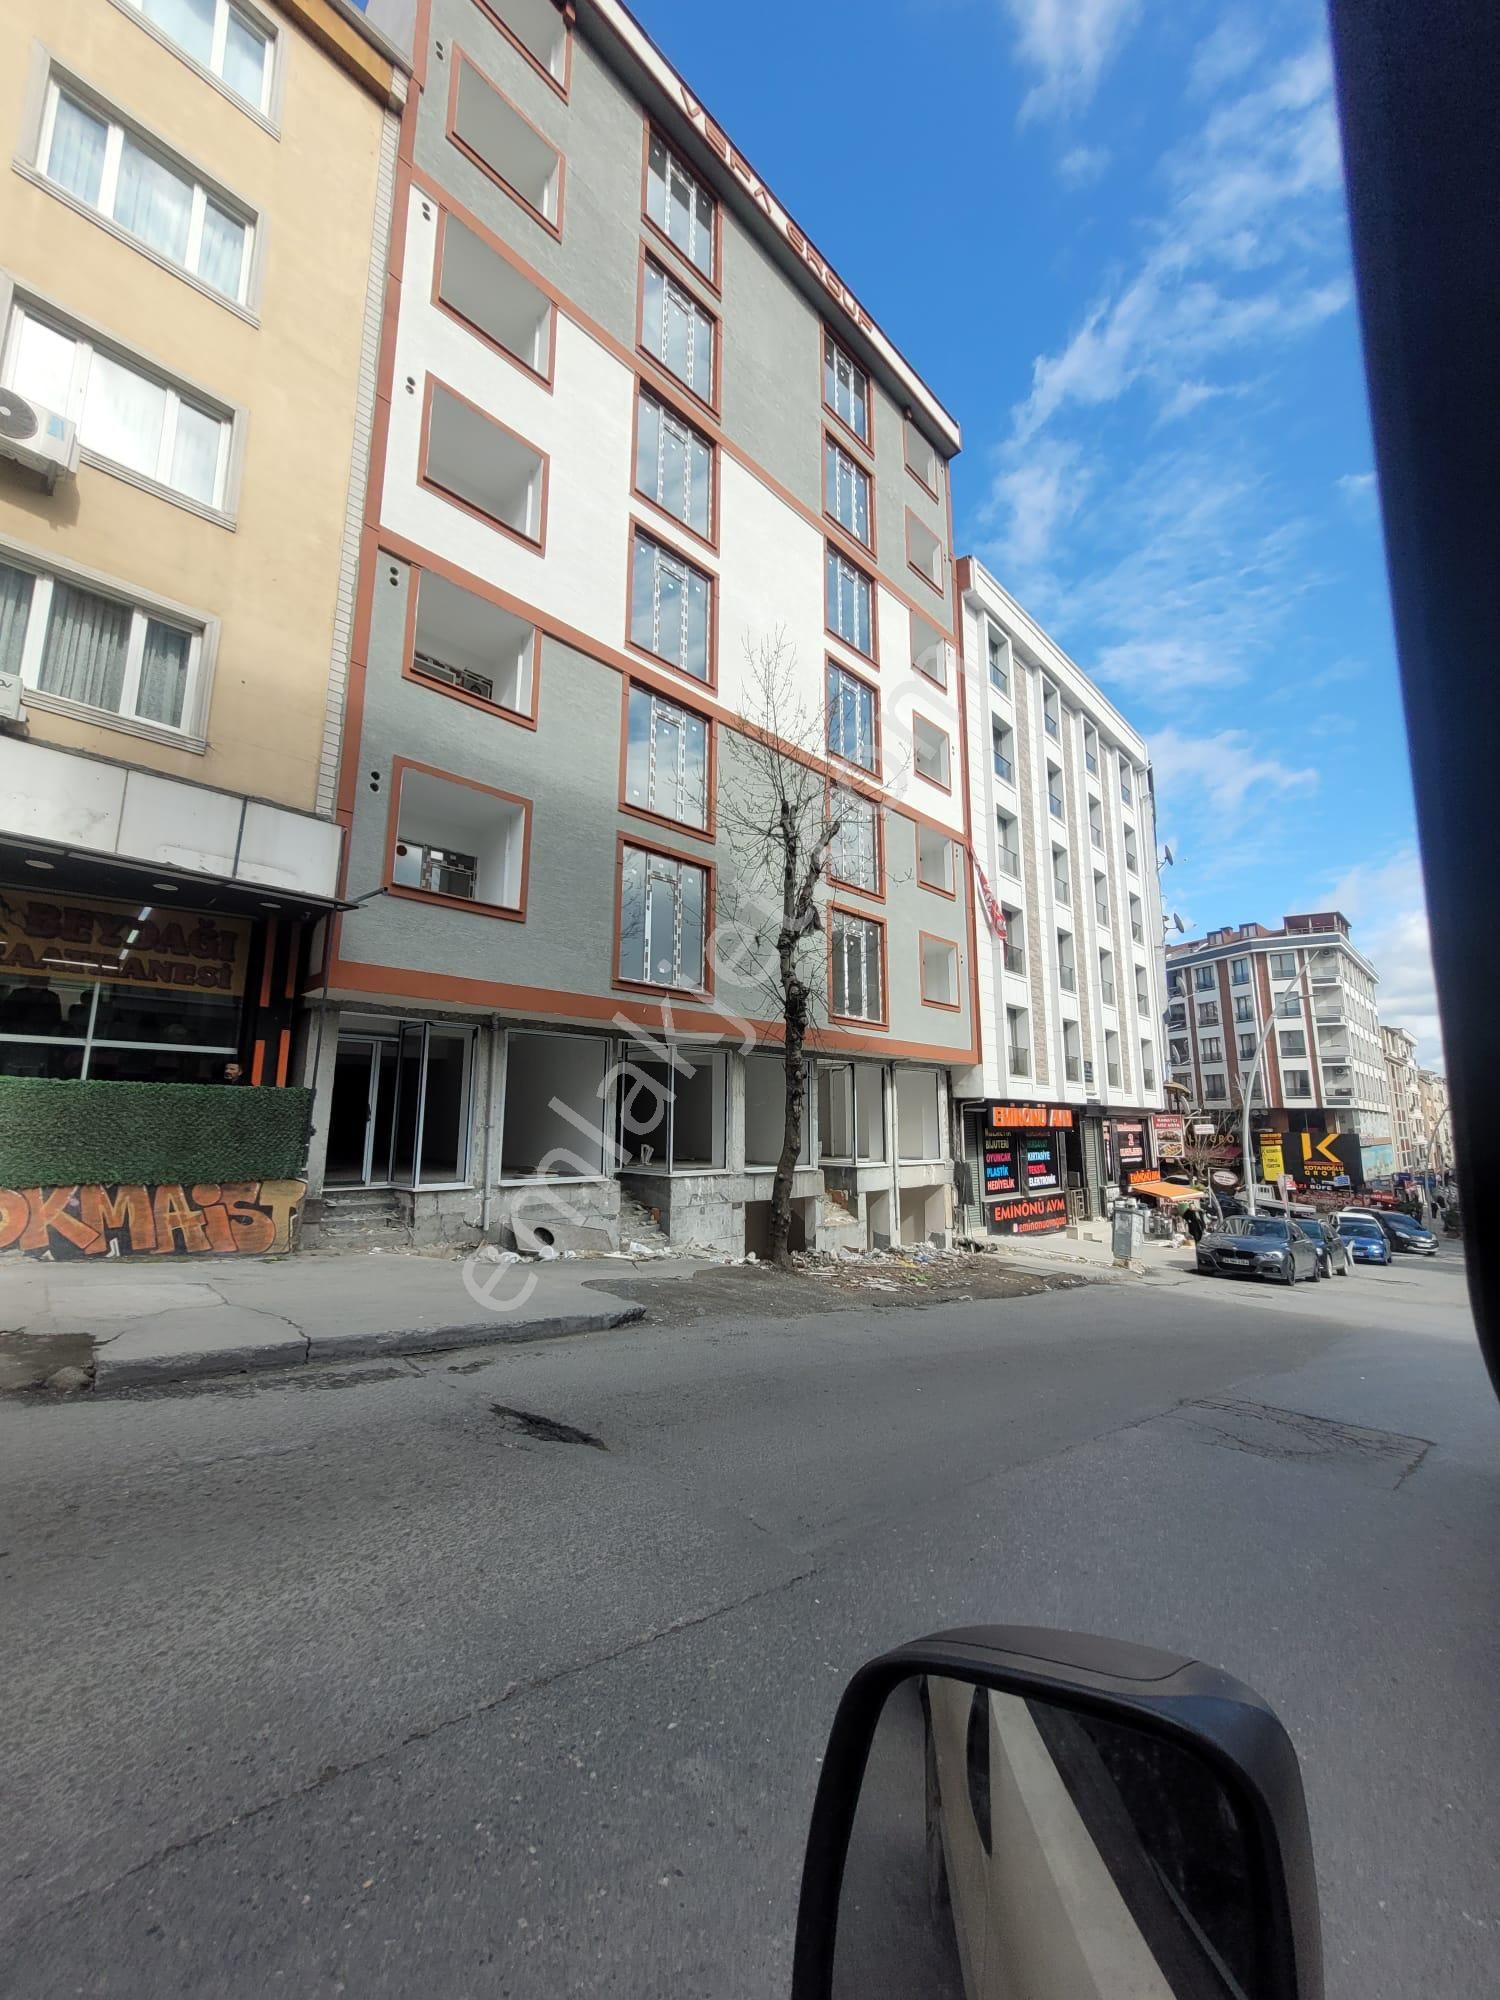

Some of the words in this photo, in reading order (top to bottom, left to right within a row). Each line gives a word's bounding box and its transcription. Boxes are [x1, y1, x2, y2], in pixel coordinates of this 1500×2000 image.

[23, 901, 239, 961] BEYDAĞI
[992, 1102, 1047, 1127] EMİNÖNÜ
[1049, 1109, 1073, 1127] AVM
[986, 1152, 1012, 1163] OYUNCAK
[986, 1165, 1009, 1178] PLASTİK
[987, 1176, 1015, 1191] HEDİYELİK
[994, 1198, 1045, 1221] EMİNÖNÜ
[1046, 1199, 1066, 1213] AVM
